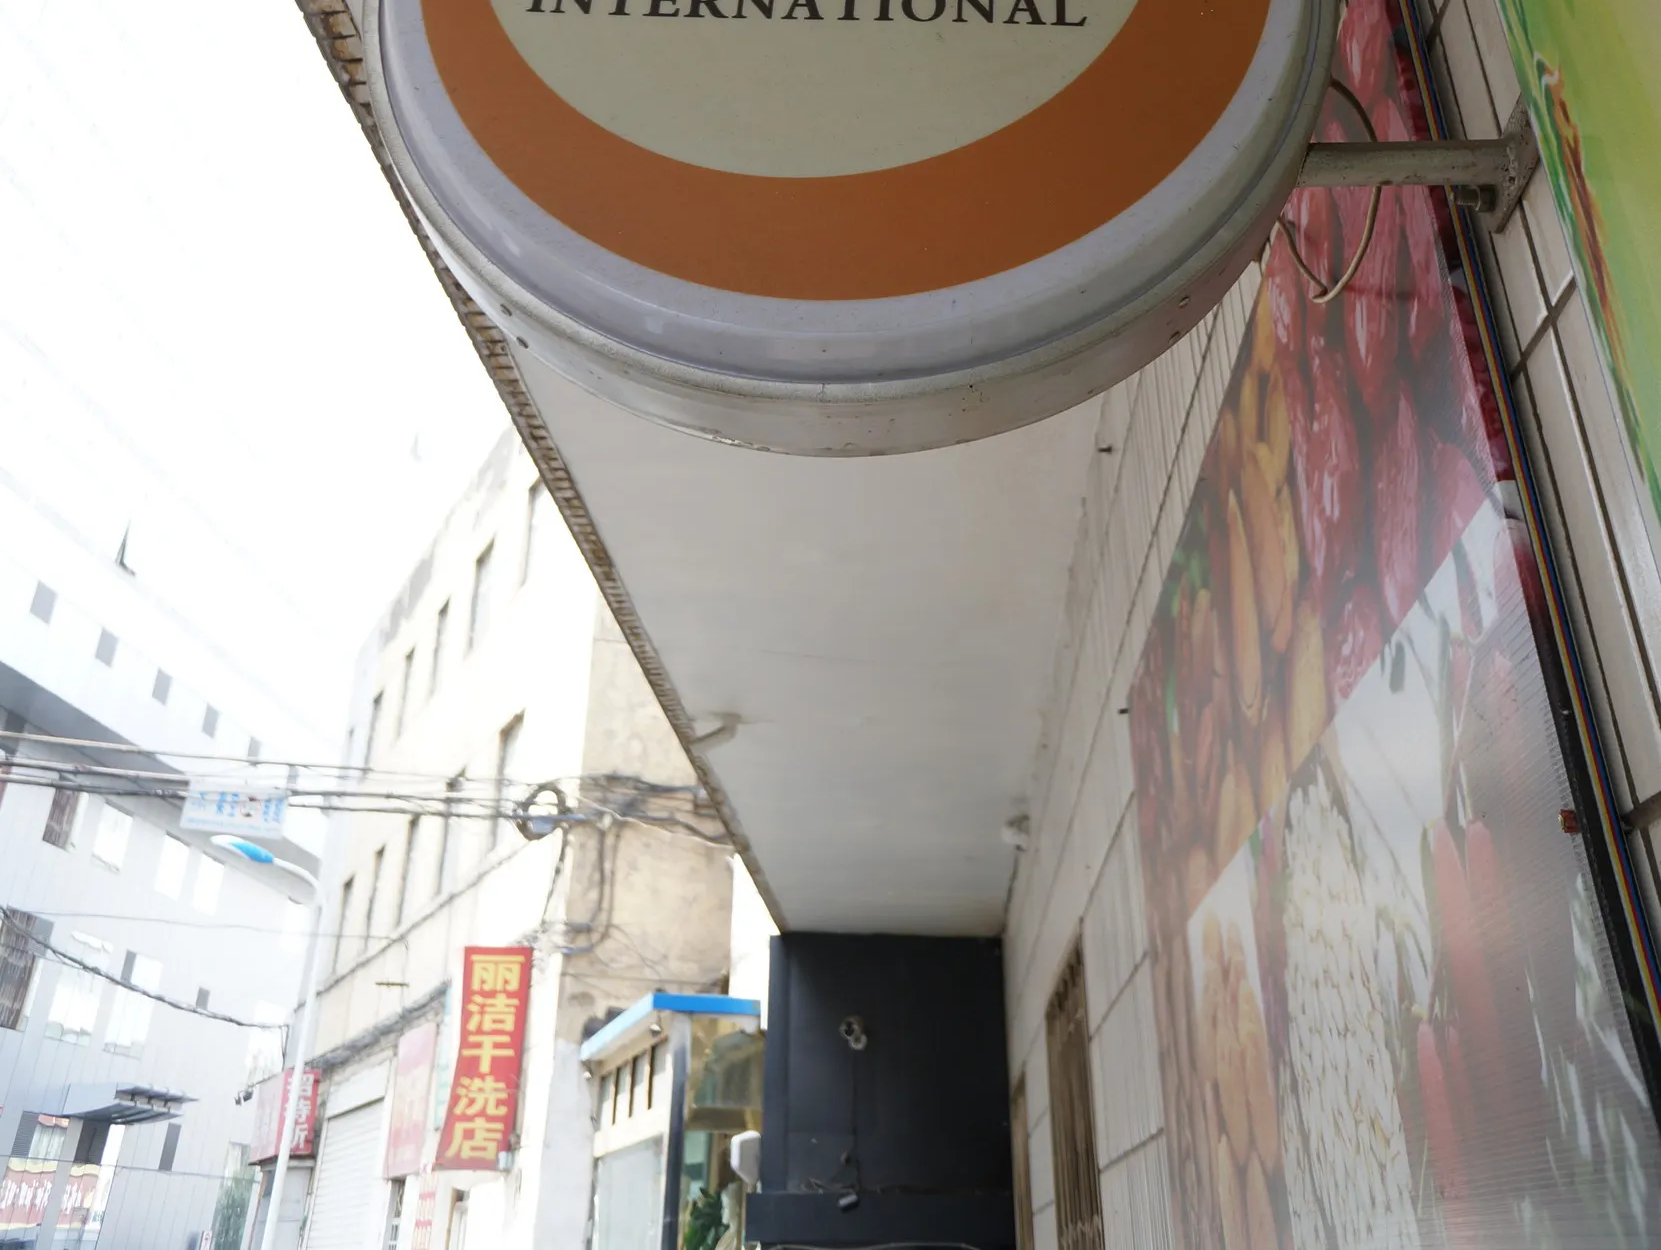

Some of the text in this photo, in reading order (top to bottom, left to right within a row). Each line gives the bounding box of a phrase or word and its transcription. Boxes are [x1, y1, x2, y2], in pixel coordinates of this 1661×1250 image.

[445, 953, 526, 1162] 丽洁干洗店
